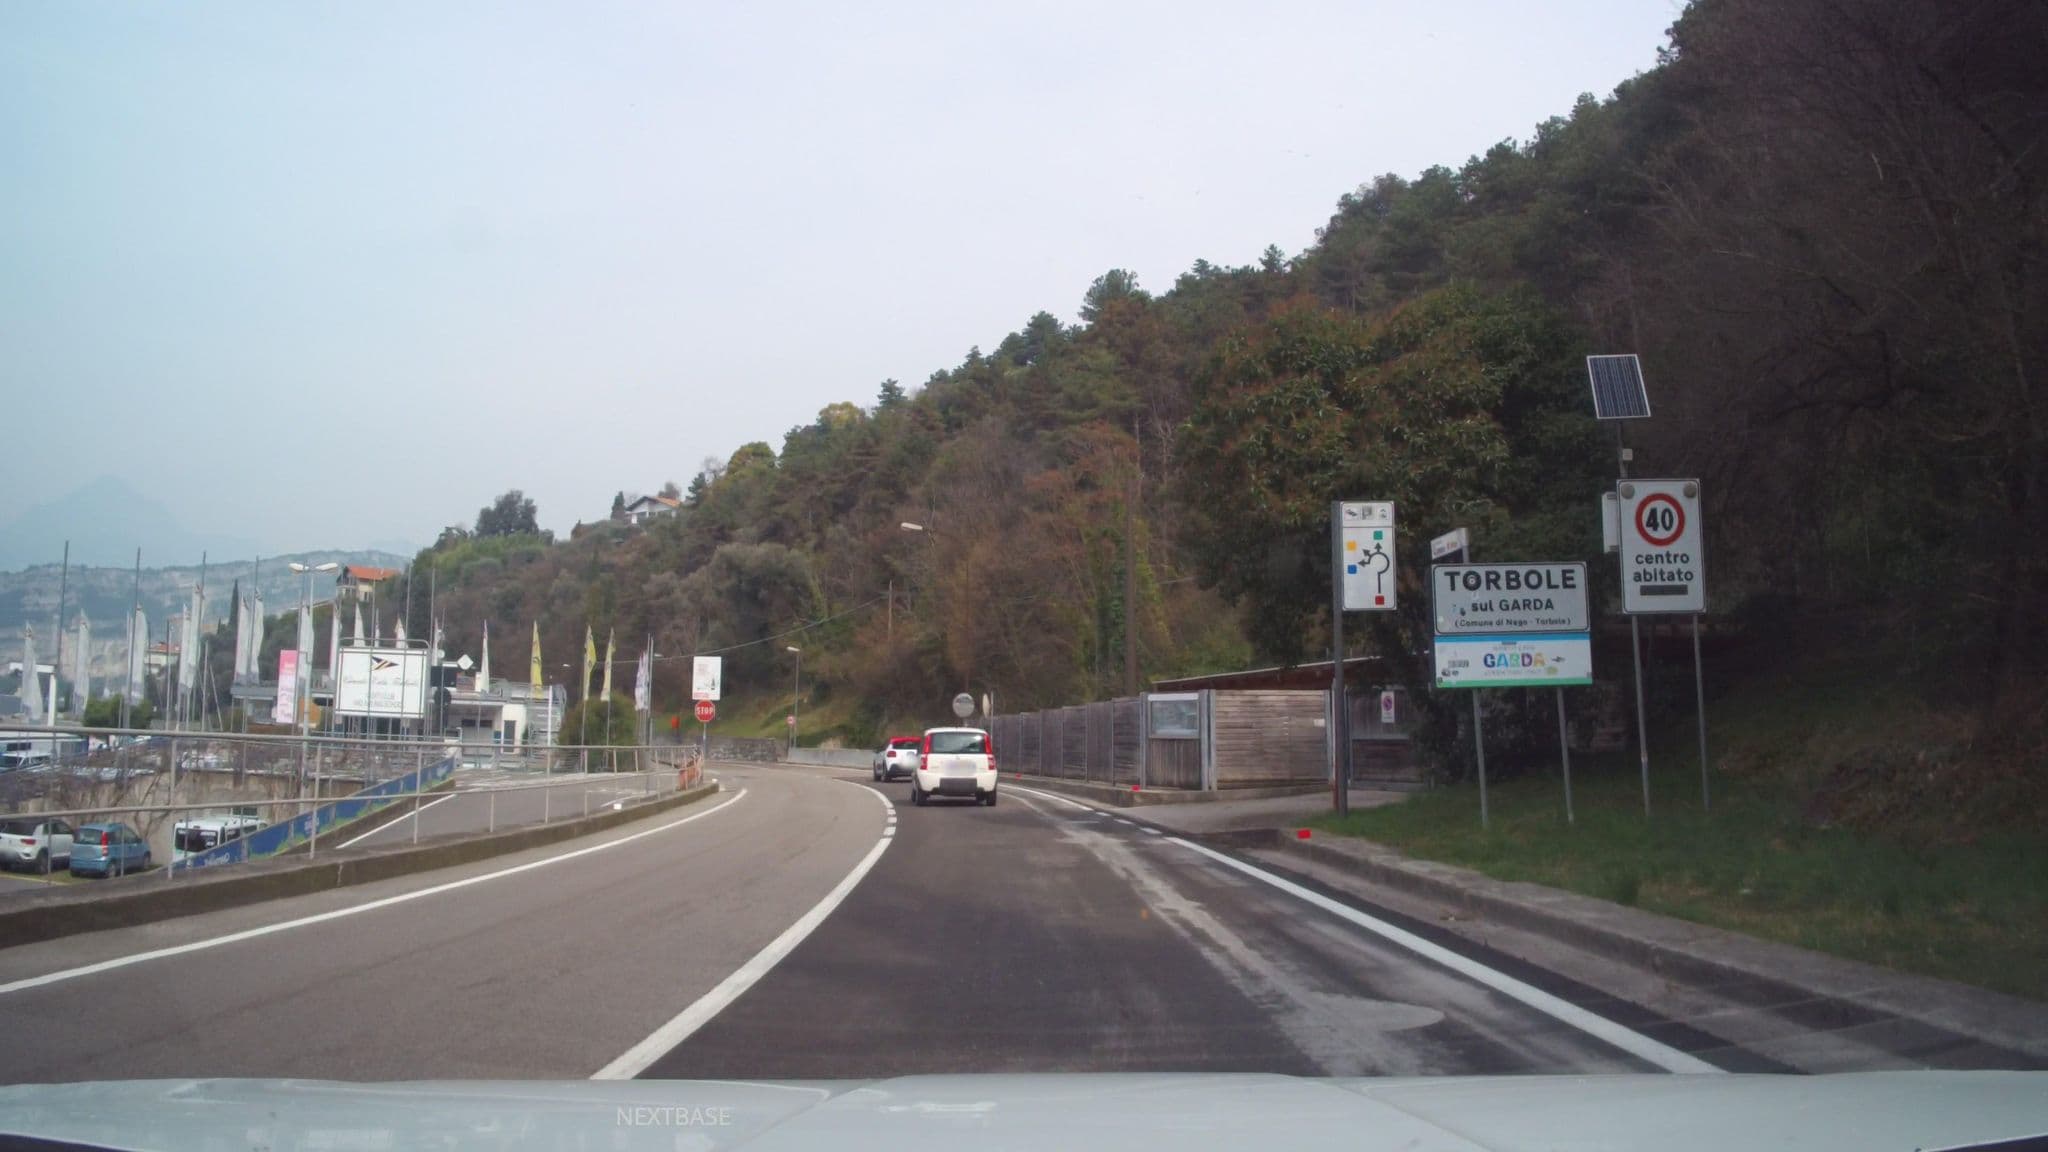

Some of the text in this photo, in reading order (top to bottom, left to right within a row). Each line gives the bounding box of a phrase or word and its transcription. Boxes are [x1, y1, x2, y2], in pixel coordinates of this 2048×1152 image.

[1646, 507, 1674, 531] 40
[1635, 550, 1690, 564] centro
[1444, 569, 1577, 591] TORBOLE
[1633, 567, 1694, 582] abitato
[1471, 598, 1555, 612] sul GARDA
[1483, 652, 1546, 668] GARDA
[696, 706, 714, 715] STOP
